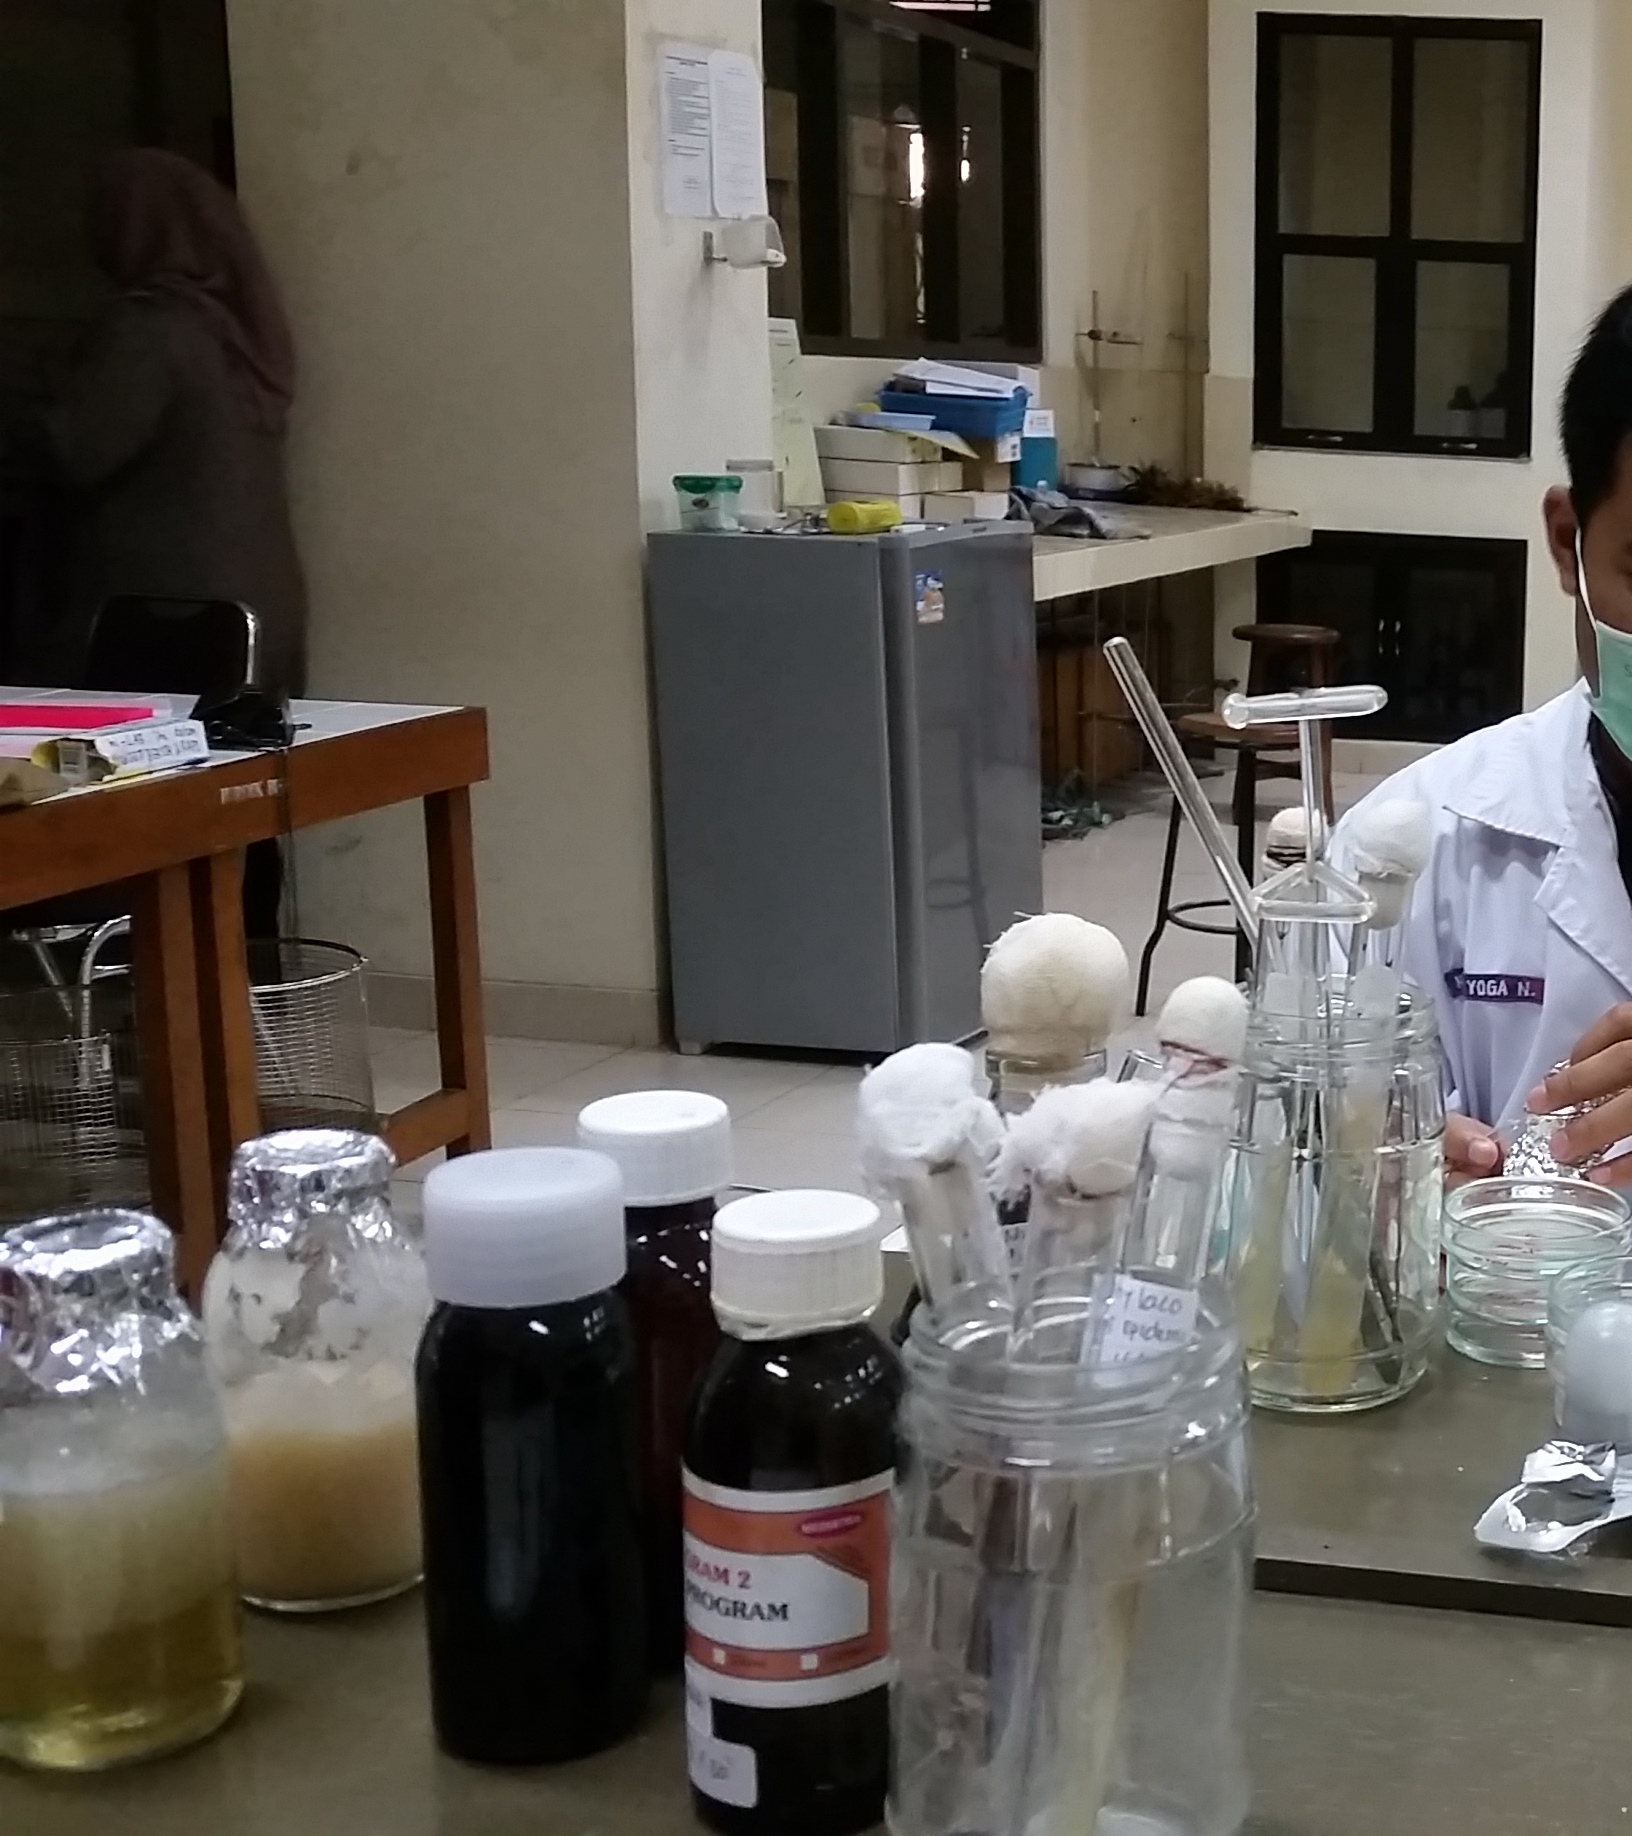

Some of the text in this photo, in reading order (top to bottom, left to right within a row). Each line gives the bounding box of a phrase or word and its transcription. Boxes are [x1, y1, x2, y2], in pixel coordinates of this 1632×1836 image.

[1466, 979, 1536, 997] YOGA N.
[737, 1570, 751, 1589] 2
